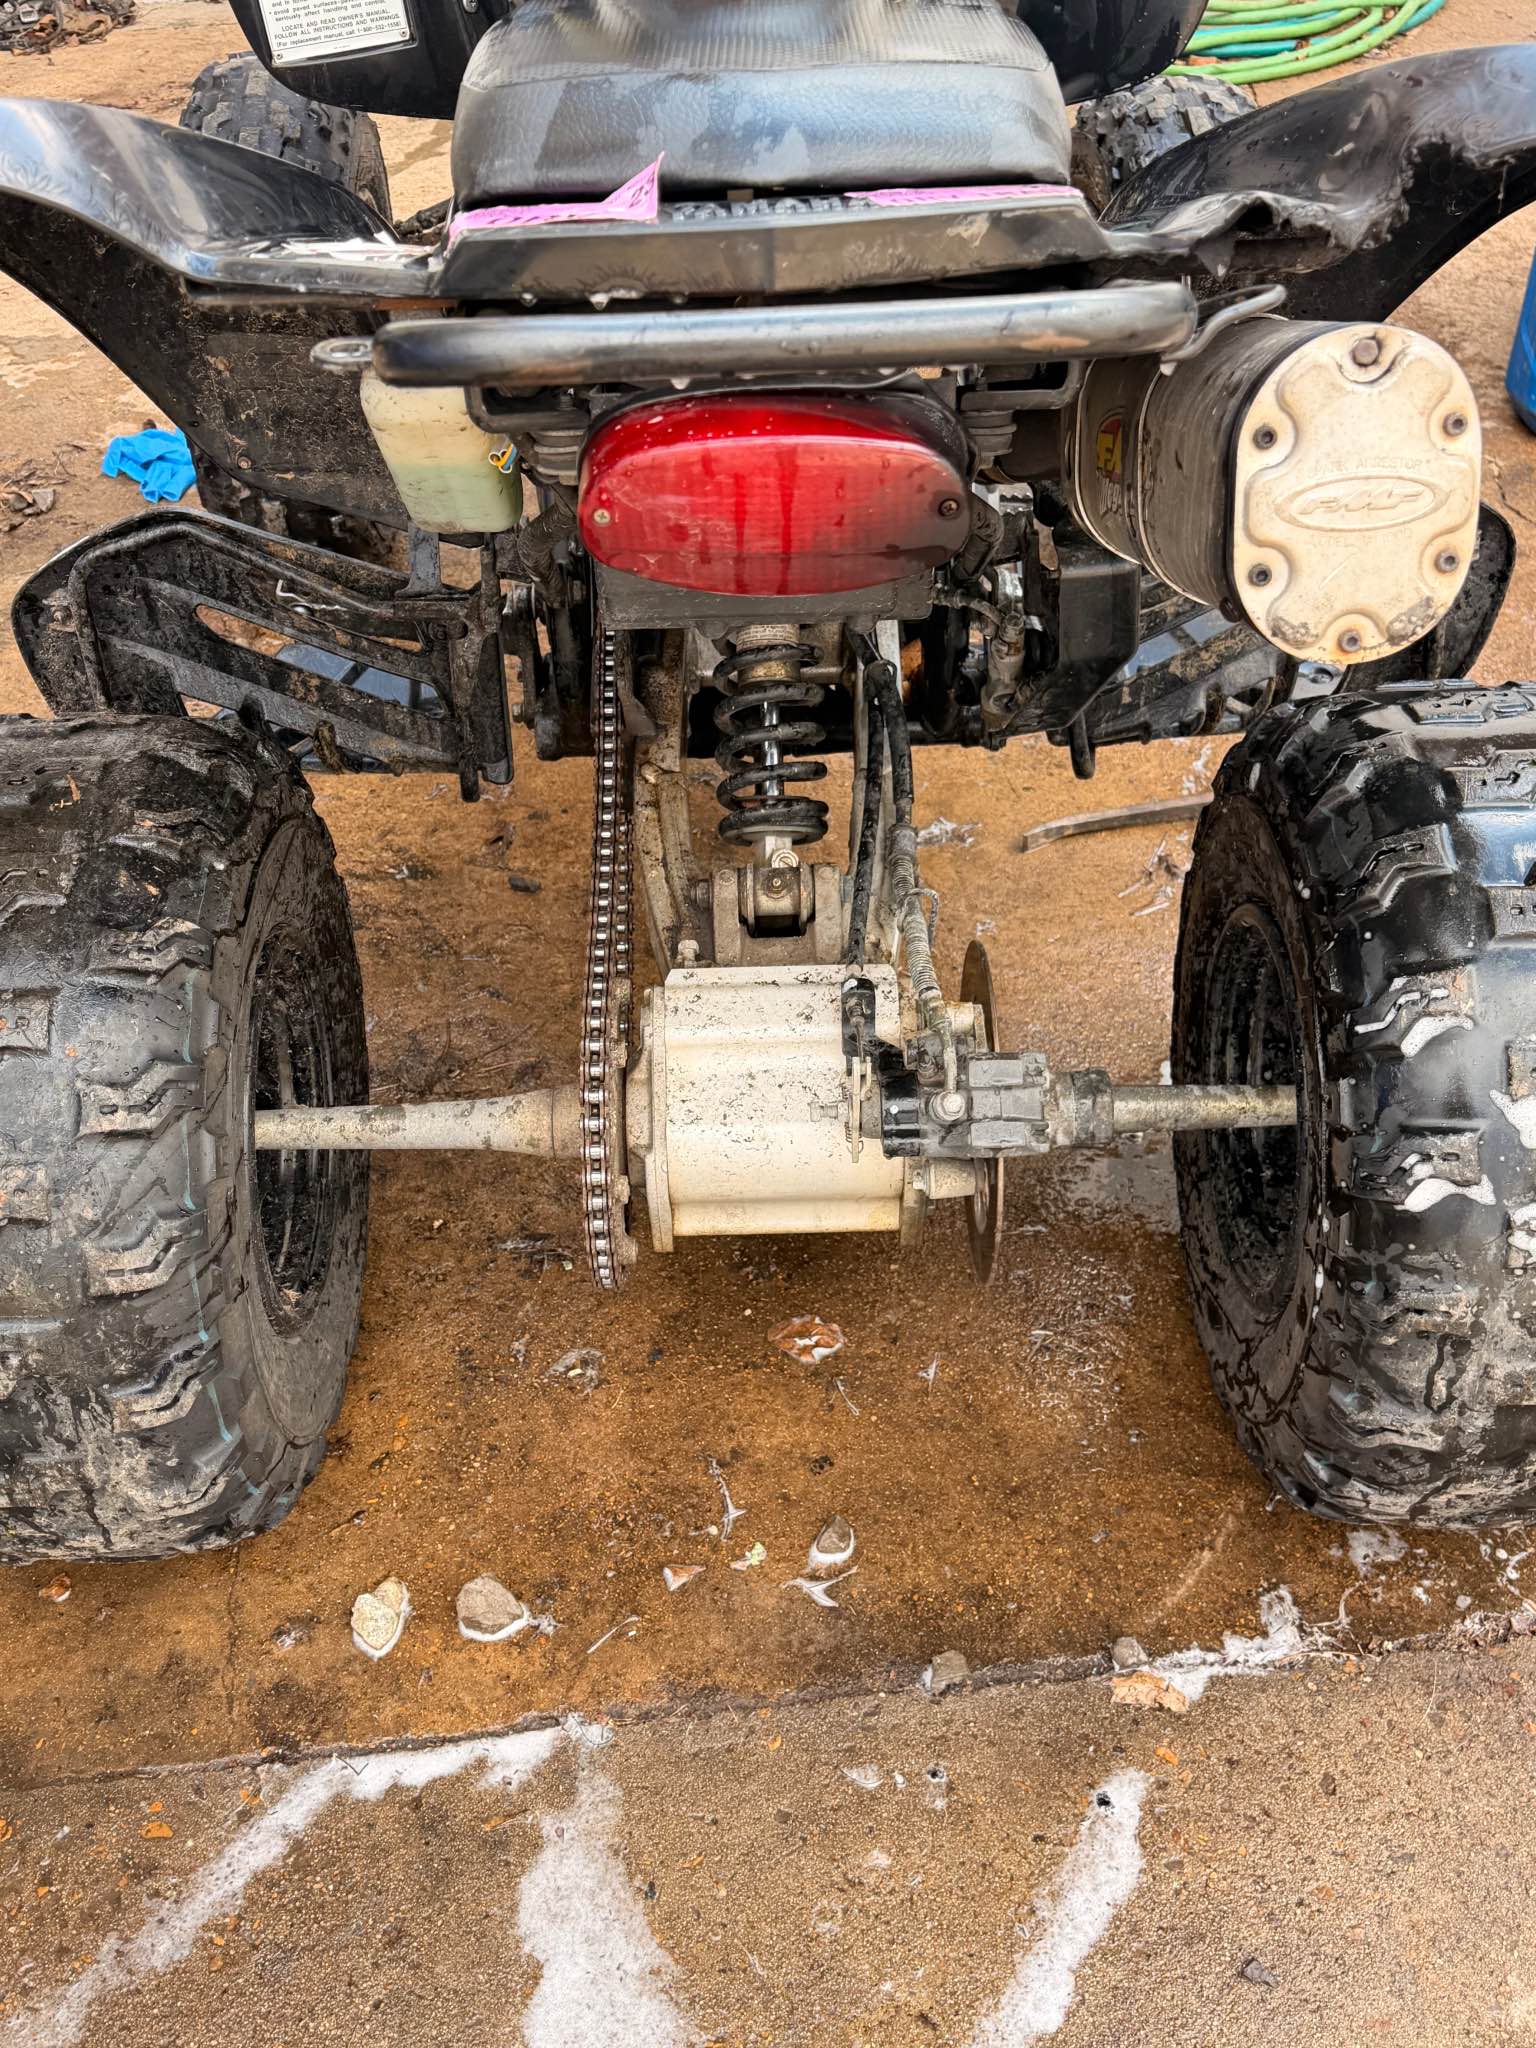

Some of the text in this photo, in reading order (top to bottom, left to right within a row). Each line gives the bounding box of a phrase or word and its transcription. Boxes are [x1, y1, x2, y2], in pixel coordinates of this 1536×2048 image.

[274, 8, 290, 16] avoid
[292, 4, 310, 13] paved
[275, 13, 301, 22] seriously
[304, 9, 320, 17] affect
[323, 5, 348, 14] handling
[274, 31, 298, 40] FOLLOW
[313, 21, 353, 33] INSTRUCTIONS
[281, 23, 304, 32] LOCATE
[306, 20, 318, 28] AND
[320, 17, 336, 25] READ
[338, 12, 364, 22] OWNER'S
[290, 35, 322, 45] replacement
[1297, 486, 1425, 516] FMF
